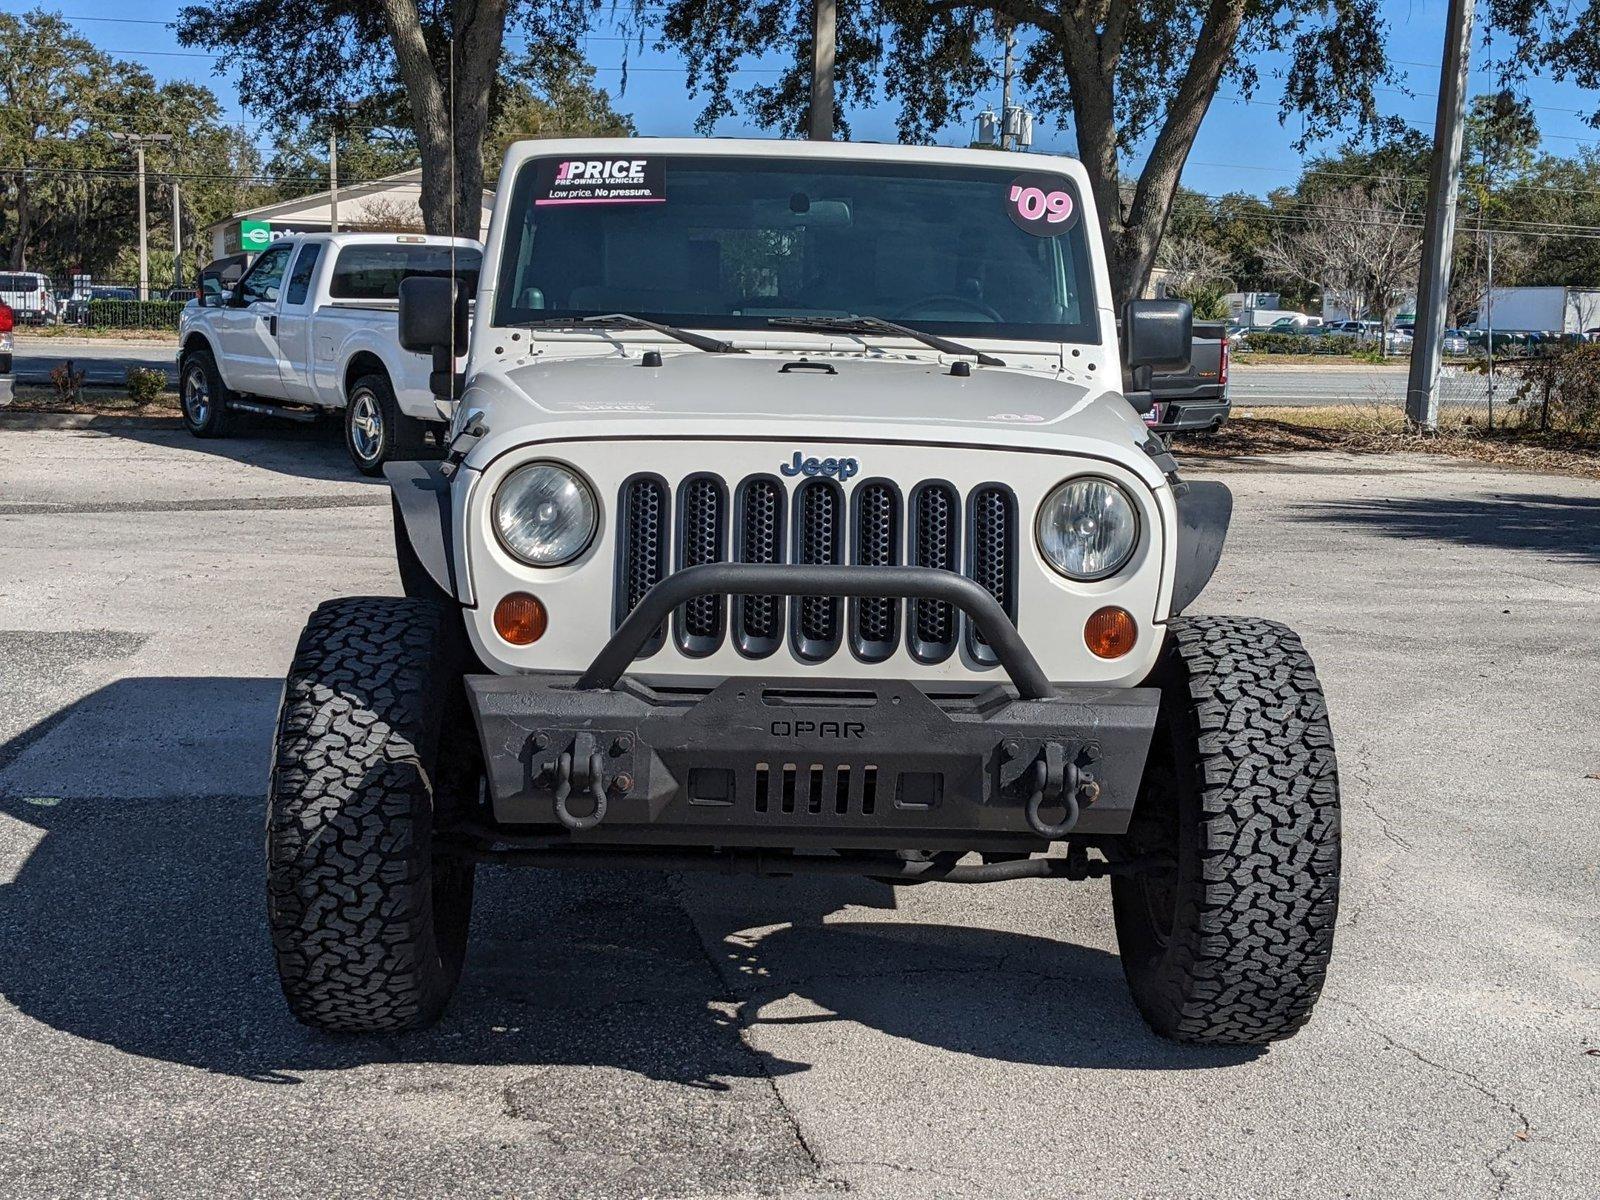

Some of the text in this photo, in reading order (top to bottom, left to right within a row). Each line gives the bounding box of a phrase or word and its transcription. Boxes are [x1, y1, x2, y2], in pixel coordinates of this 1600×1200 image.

[556, 160, 647, 179] 1PRICE
[555, 178, 603, 186] PRE-OWNED
[549, 188, 652, 198] Low price. No pressure.
[1010, 185, 1073, 223] '09
[780, 451, 859, 482] Jeep
[771, 721, 865, 738] OPAR
